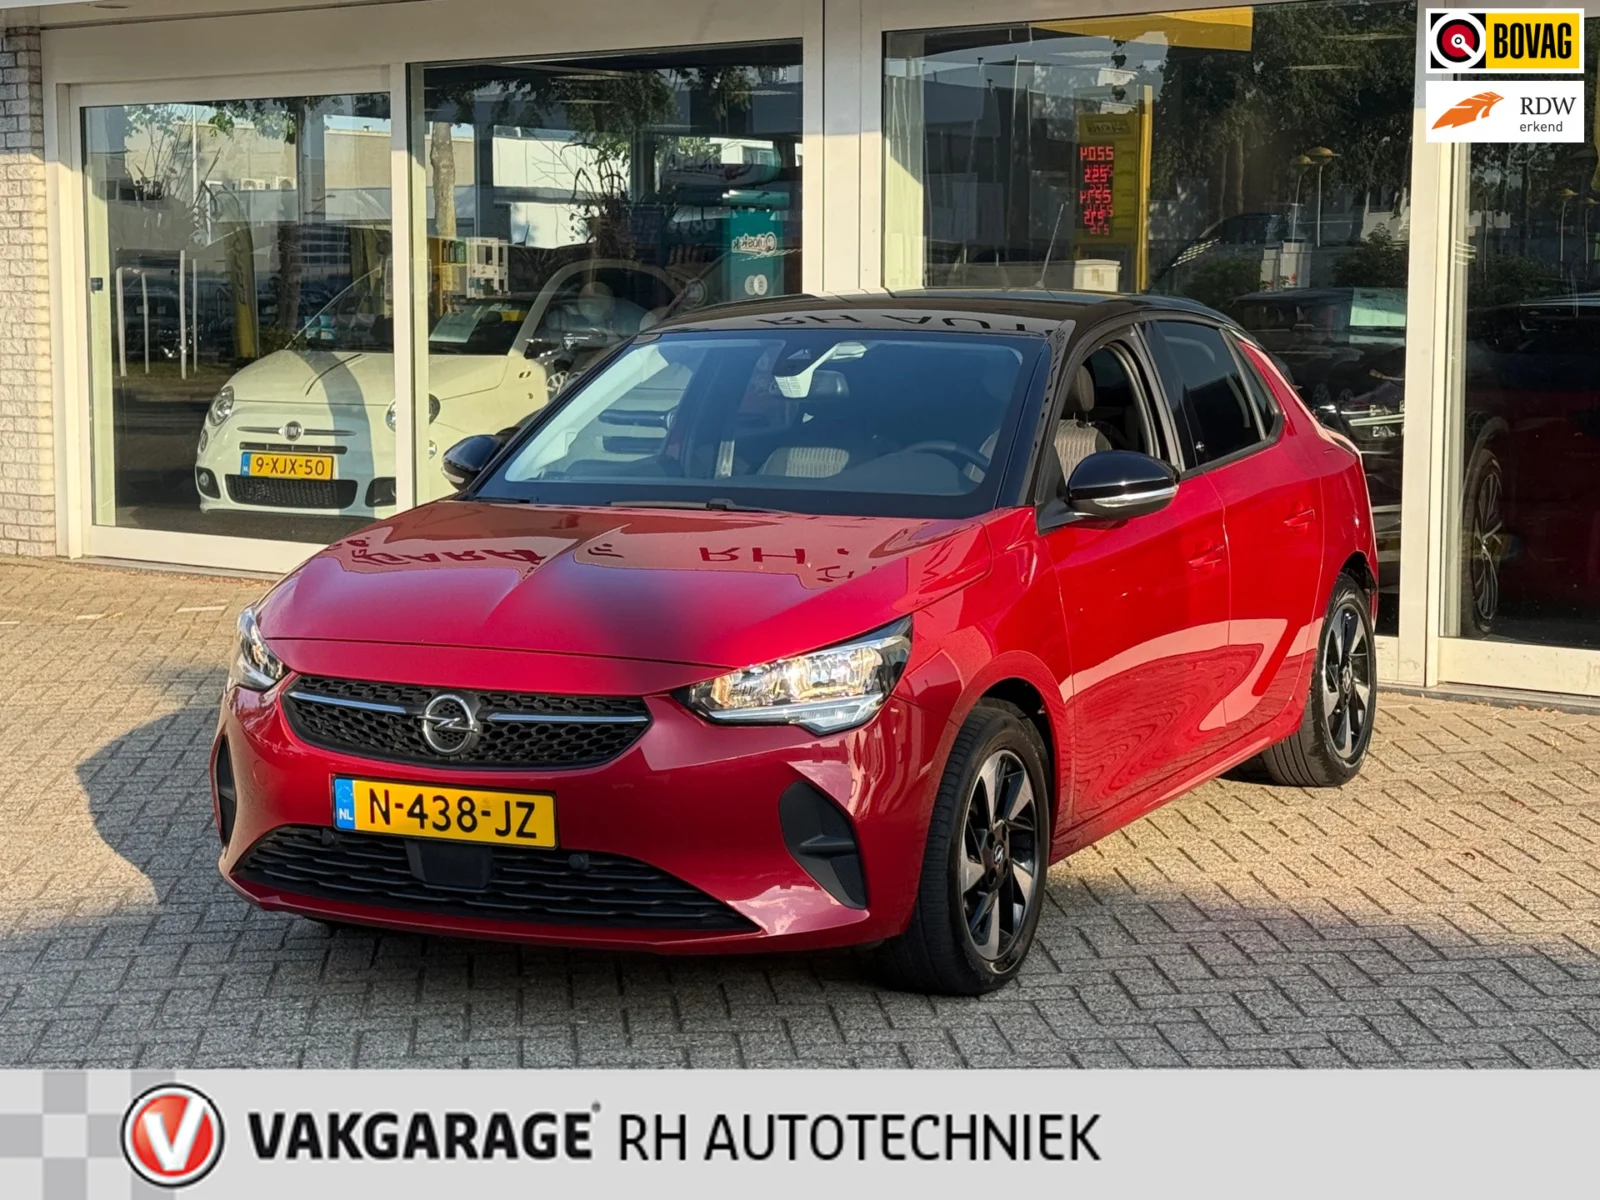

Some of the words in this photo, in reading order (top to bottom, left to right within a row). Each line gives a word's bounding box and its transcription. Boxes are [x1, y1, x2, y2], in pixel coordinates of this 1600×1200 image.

[256, 457, 325, 476] 9-XJX-50
[338, 808, 353, 821] NL
[369, 788, 537, 839] N-438-JZ
